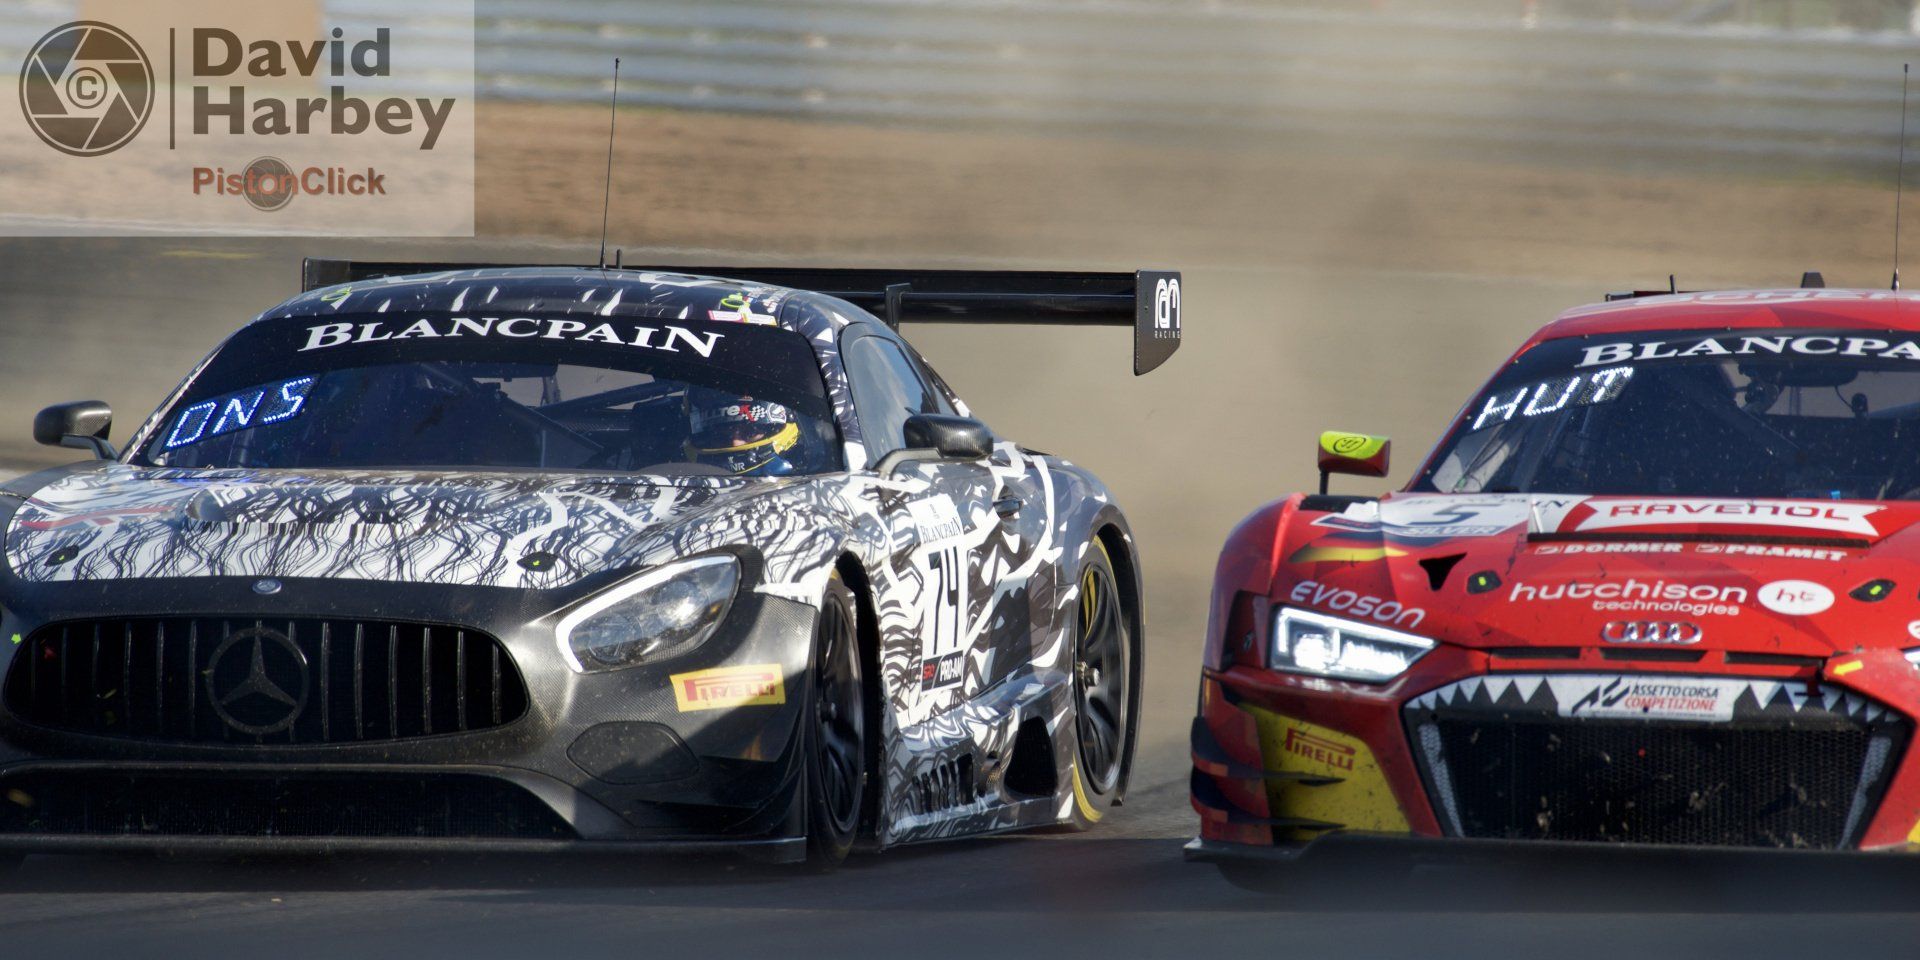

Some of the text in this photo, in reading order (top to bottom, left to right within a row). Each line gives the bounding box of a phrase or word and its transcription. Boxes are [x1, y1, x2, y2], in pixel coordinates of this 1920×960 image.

[298, 317, 724, 358] BLANCPAIN
[1154, 330, 1181, 339] RACING
[1409, 503, 1503, 525] 5
[919, 516, 961, 544] BLANCPAIN
[1403, 525, 1494, 536] SILVER
[1564, 543, 1848, 562] DORMER PRAMET
[928, 546, 959, 655] 74
[1509, 578, 1748, 603] hutchison
[1593, 600, 1740, 617] technologies
[684, 673, 775, 702] PIRELLI
[1631, 684, 1719, 699] ASSETTO CORSA
[1624, 696, 1717, 711] COMPETIZIONE
[1286, 727, 1356, 771] PIRELLI
